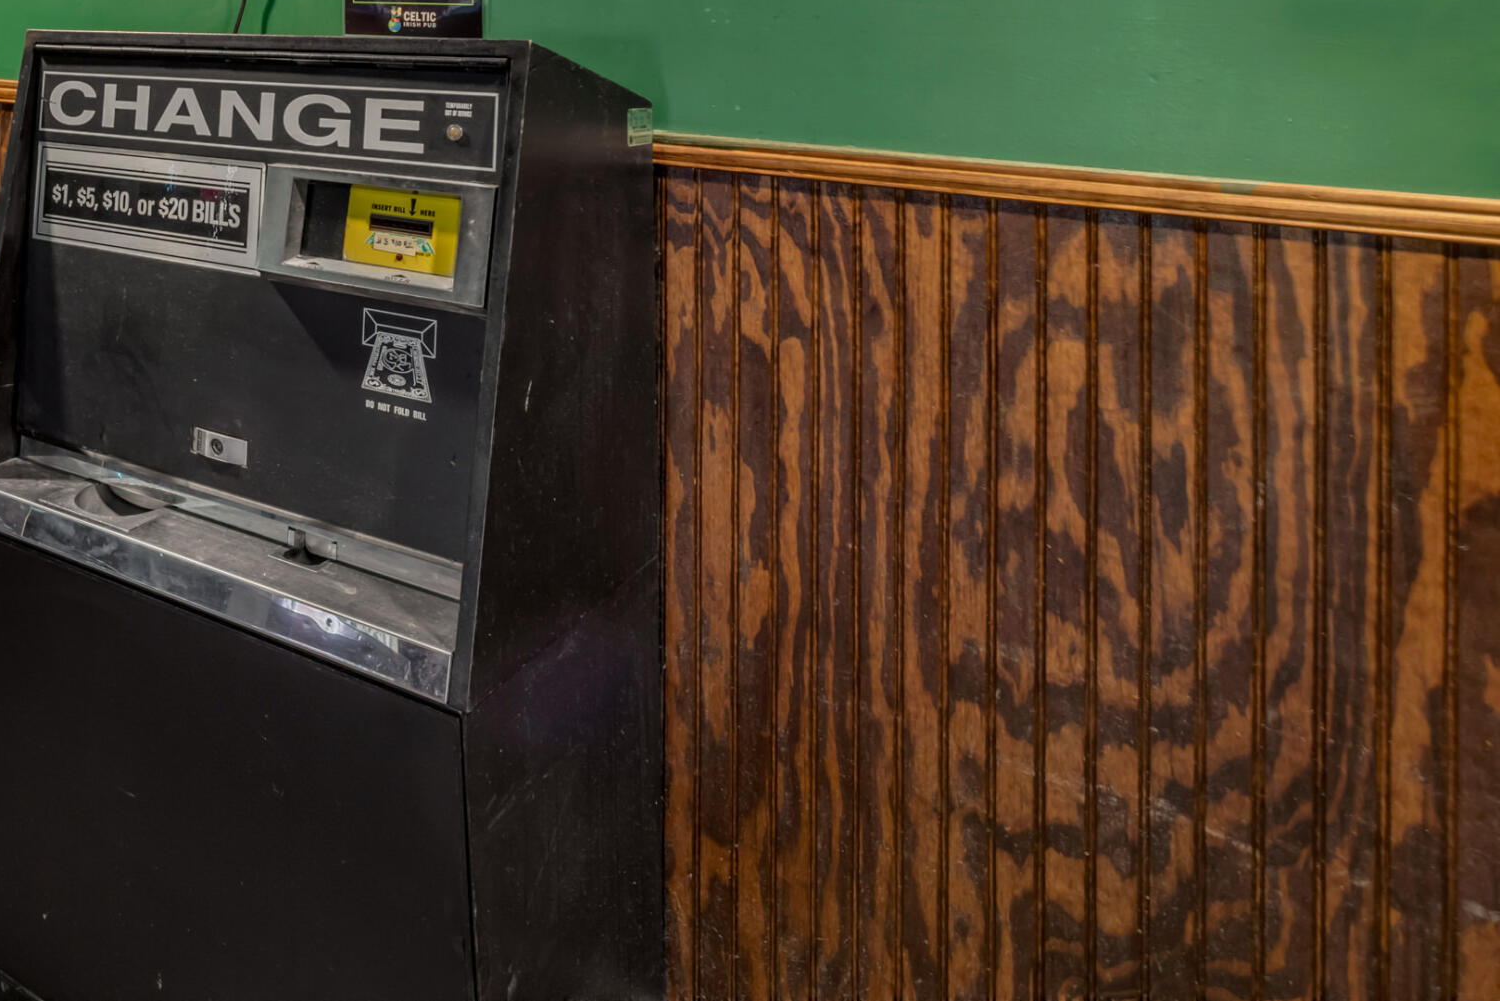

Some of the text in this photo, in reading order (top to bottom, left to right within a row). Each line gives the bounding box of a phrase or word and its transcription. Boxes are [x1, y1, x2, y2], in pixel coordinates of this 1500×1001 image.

[403, 10, 437, 22] CELTIC
[48, 80, 425, 154] CHANGE
[52, 183, 242, 228] $1, $5, $10, or $20 BILLS
[371, 203, 392, 212] INSERT
[365, 399, 427, 421] DO NOT FOLD BILL
